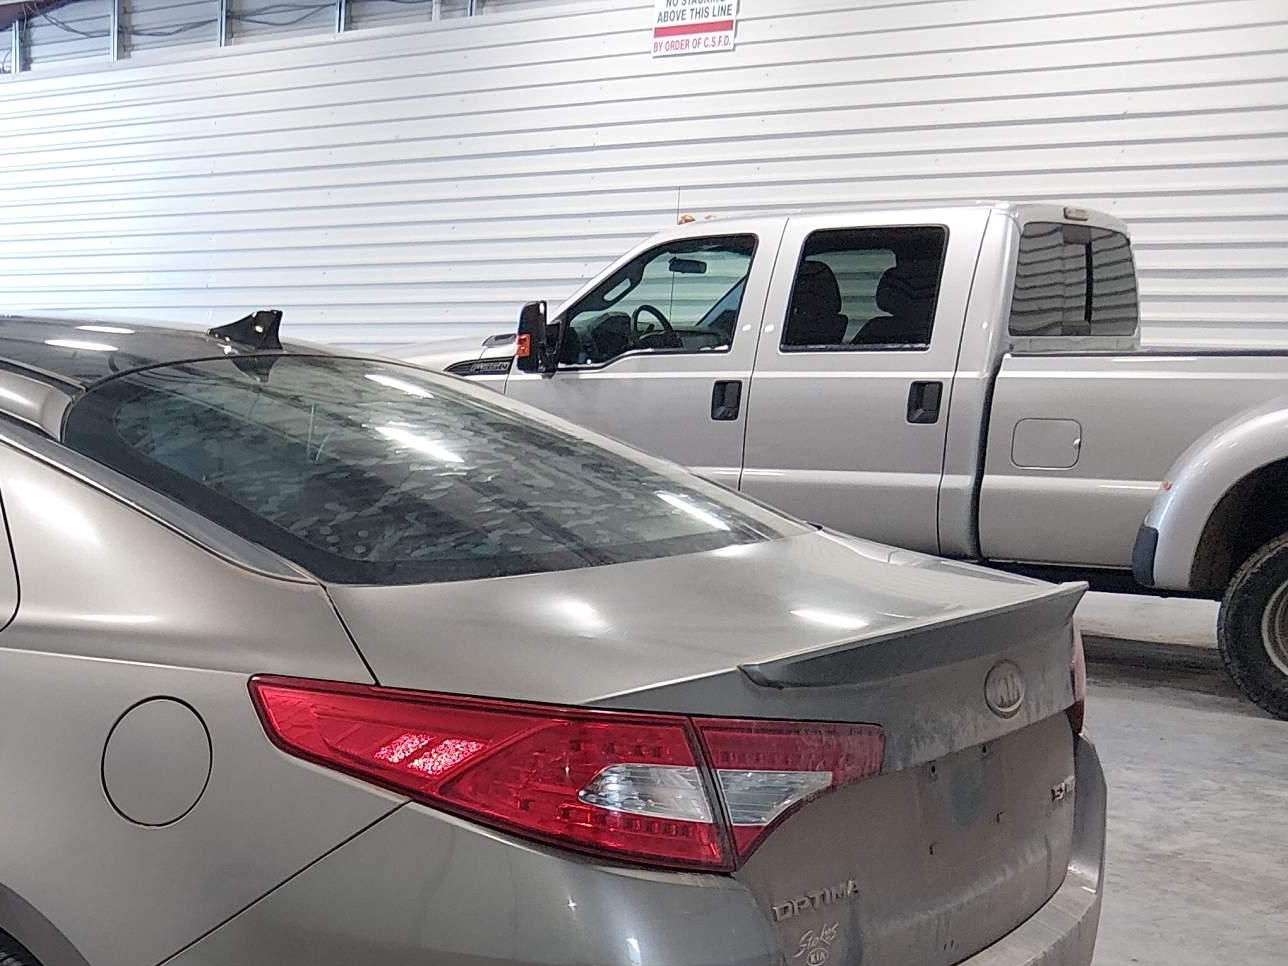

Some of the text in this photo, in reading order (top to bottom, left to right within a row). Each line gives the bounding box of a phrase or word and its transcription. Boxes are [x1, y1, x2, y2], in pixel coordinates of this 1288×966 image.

[656, 4, 733, 24] ABOVE THIS LINE
[653, 40, 664, 53] BY
[665, 38, 690, 52] ORDER
[692, 37, 703, 49] OF
[772, 879, 859, 921] OPTIMA
